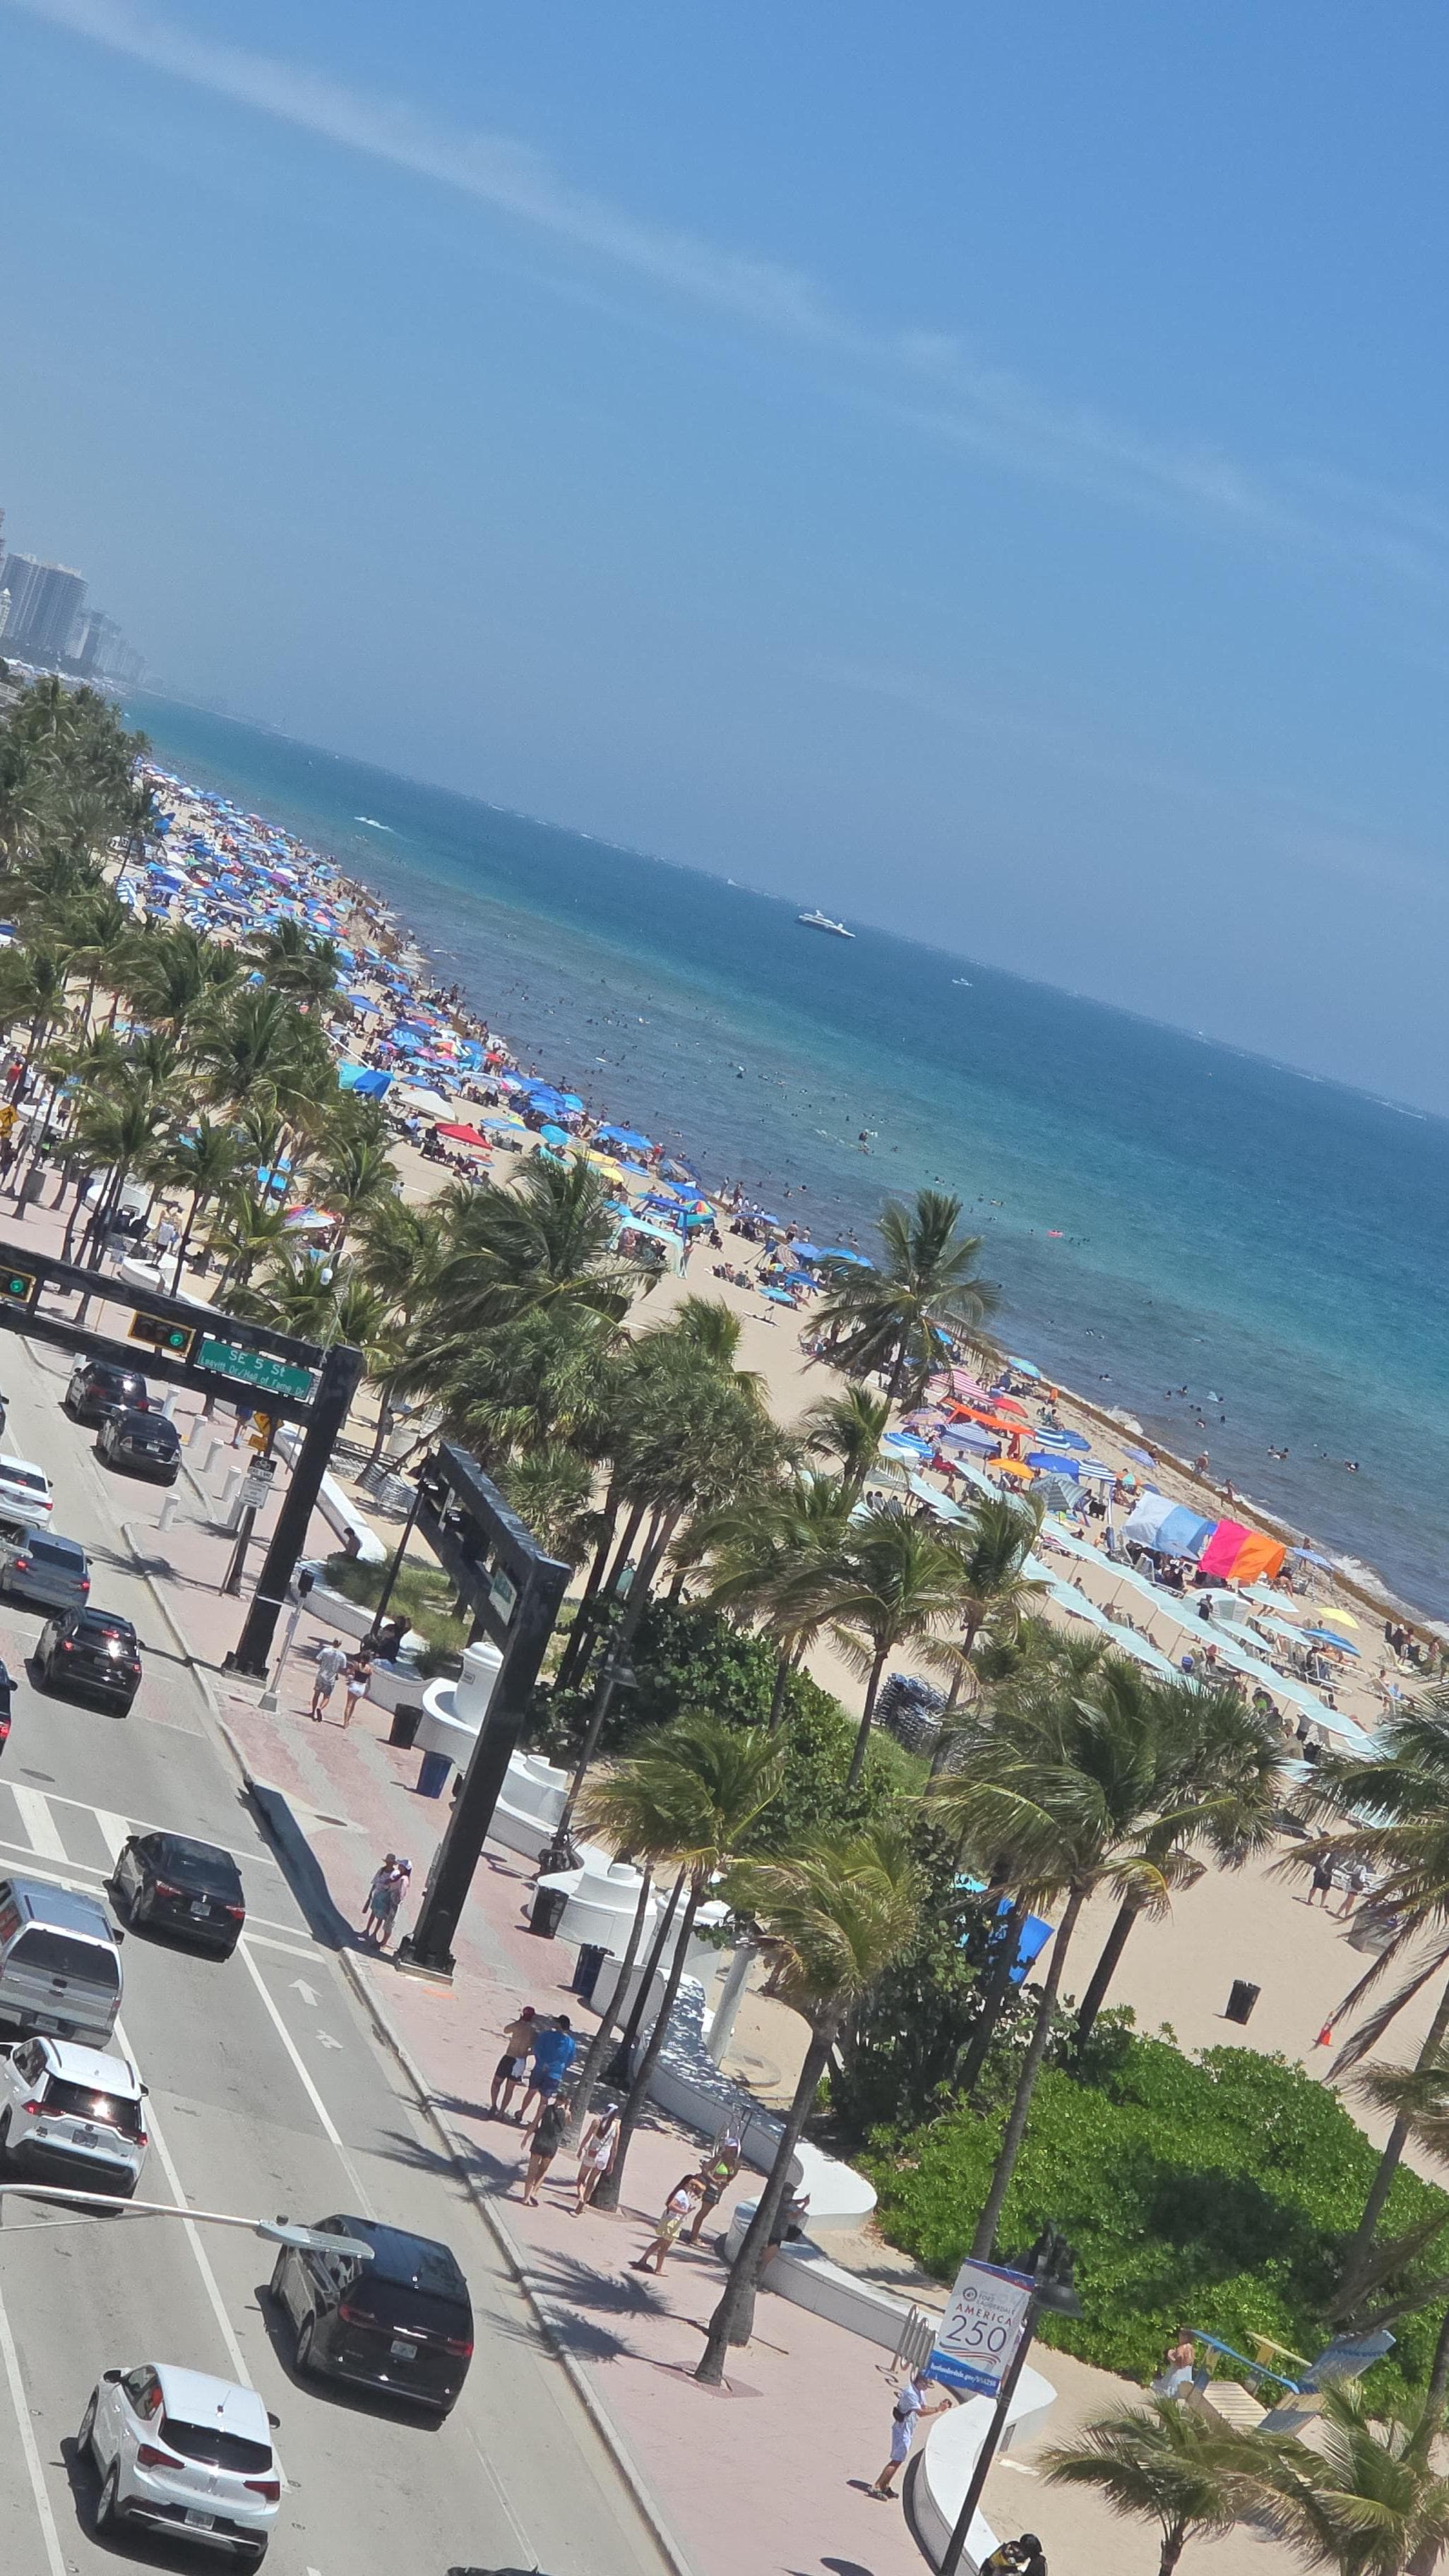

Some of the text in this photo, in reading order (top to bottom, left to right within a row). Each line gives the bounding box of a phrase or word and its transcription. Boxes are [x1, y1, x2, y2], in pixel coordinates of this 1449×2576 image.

[229, 1349, 286, 1377] SE 5 St
[260, 1376, 269, 1385] of
[272, 1379, 292, 1393] Fame
[294, 1386, 305, 1396] Dr
[955, 2303, 1012, 2326] AMERICA
[946, 2315, 1007, 2352] 250
